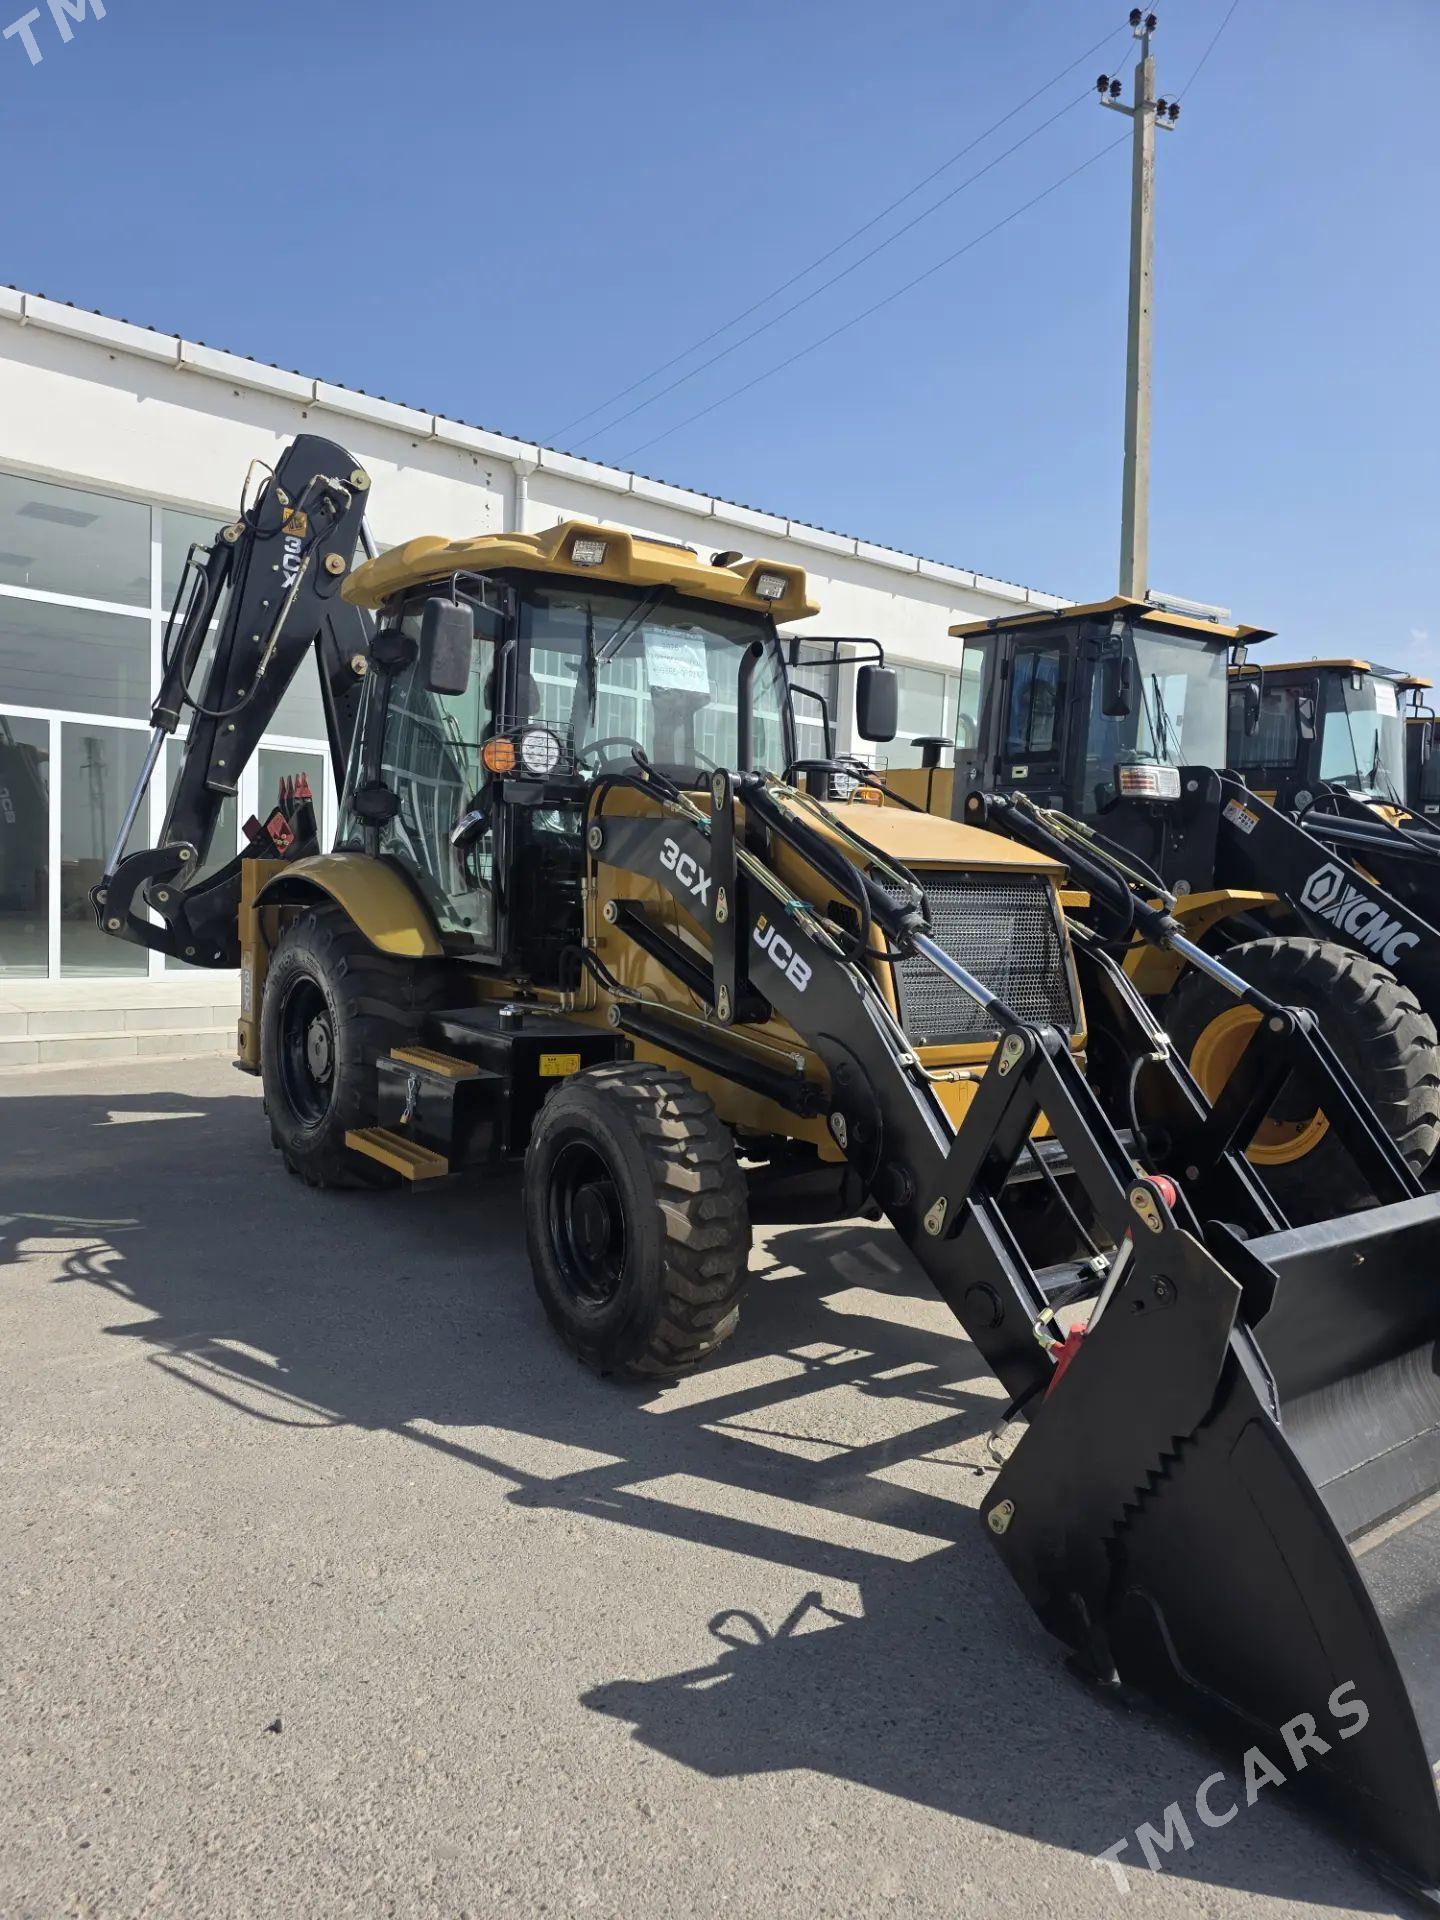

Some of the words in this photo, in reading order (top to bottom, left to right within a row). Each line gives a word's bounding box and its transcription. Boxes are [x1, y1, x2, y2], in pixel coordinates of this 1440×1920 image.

[281, 535, 302, 588] 3CX
[659, 837, 713, 907] 3CX
[752, 924, 813, 993] JCB
[1317, 883, 1421, 967] XCMC
